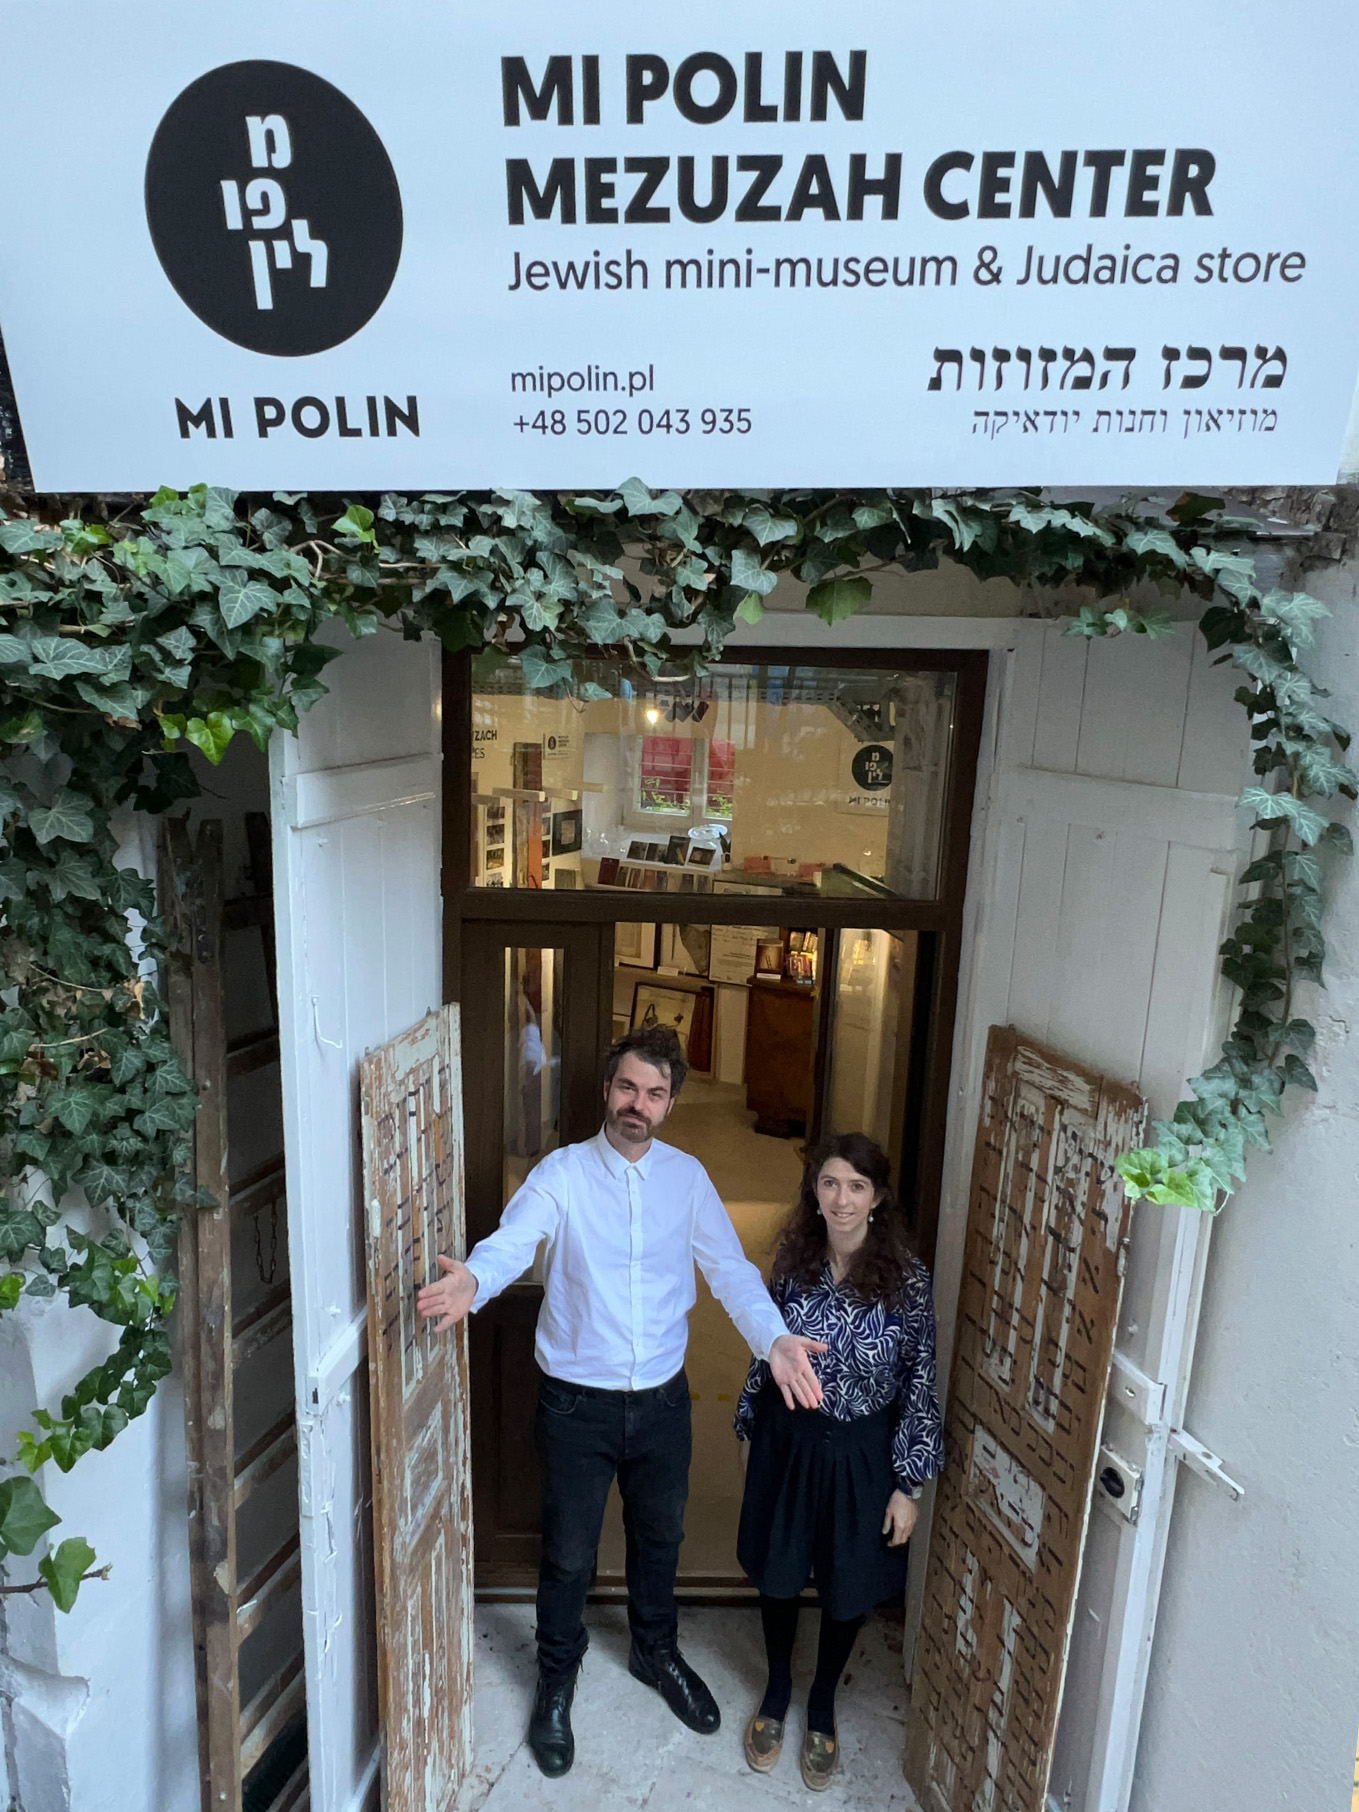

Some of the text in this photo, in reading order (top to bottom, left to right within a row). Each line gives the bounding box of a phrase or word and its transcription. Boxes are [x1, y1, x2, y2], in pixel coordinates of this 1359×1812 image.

[502, 50, 867, 126] MI POLIN
[506, 149, 1215, 224] MEZUZAH CENTER
[509, 244, 1306, 291] Jewish mini-museum & Judaica store
[512, 364, 655, 397] mipolin.pl
[927, 344, 1288, 391] מרכז המזוזות
[175, 395, 420, 439] MI POLIN
[514, 408, 751, 435] +48 502 043 935
[972, 408, 1278, 440] מוזיאון וחנות יודאיקה
